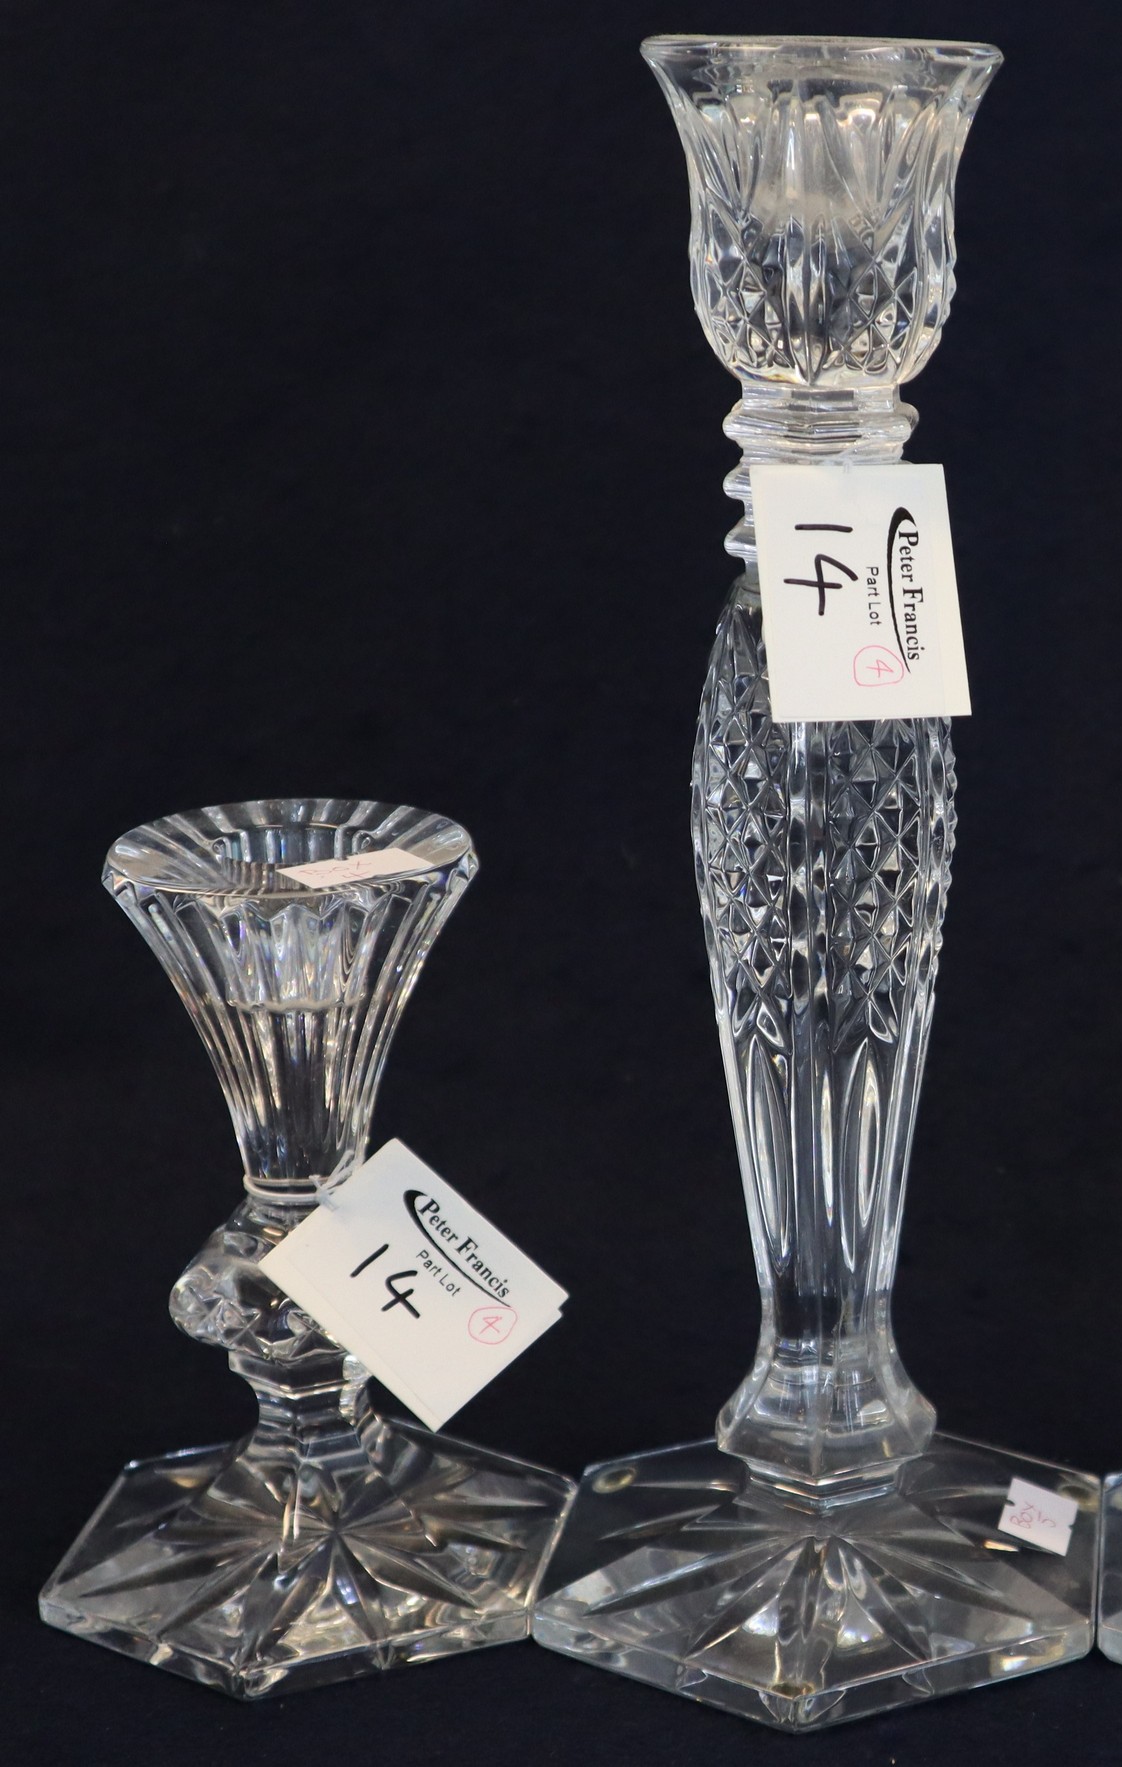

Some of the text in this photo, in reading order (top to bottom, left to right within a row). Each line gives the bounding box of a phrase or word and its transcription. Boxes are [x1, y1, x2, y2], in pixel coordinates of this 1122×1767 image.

[784, 522, 859, 616] 14
[866, 566, 882, 626] Part Lot
[898, 530, 925, 661] Peter Francis
[350, 1243, 421, 1319] 14
[415, 1249, 462, 1297] Part Lot
[418, 1198, 510, 1299] Peter Francis
